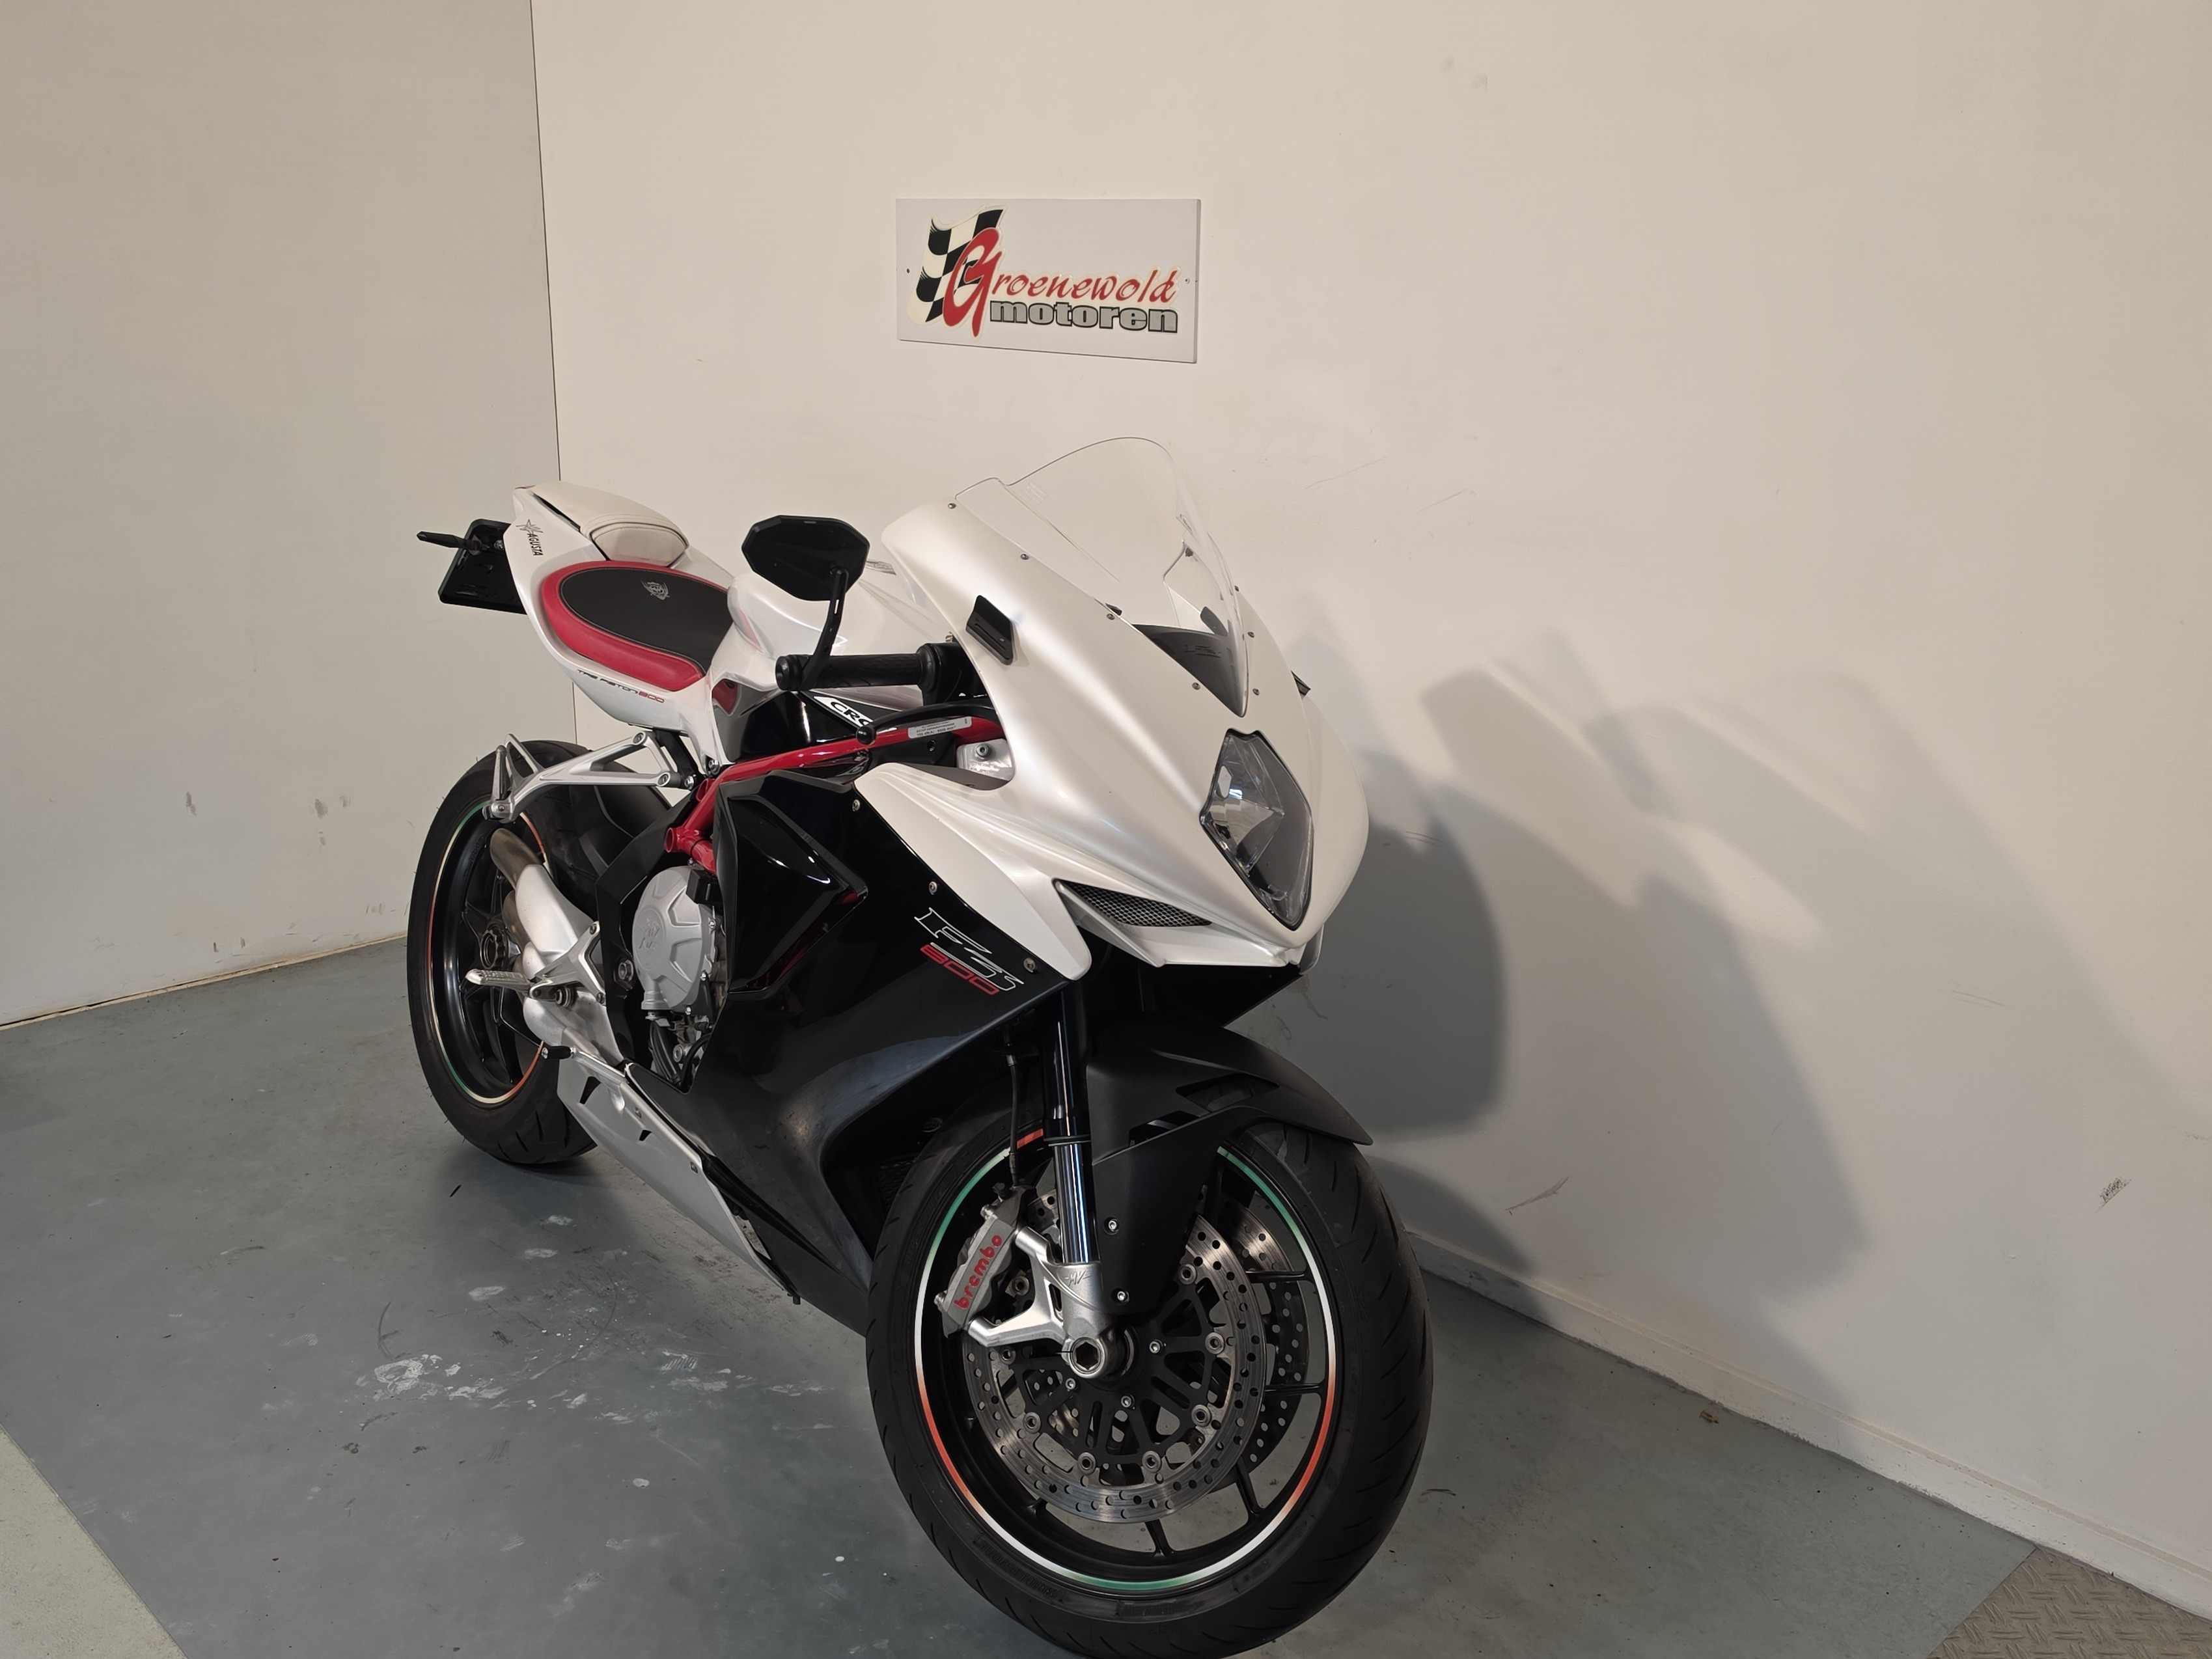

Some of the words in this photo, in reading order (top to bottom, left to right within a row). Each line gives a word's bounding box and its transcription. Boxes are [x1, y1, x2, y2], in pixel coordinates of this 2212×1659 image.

[943, 227, 1177, 338] Groenewold
[989, 300, 1178, 334] motoren
[527, 533, 544, 556] AGUSTA
[953, 1235, 1002, 1309] brembo
